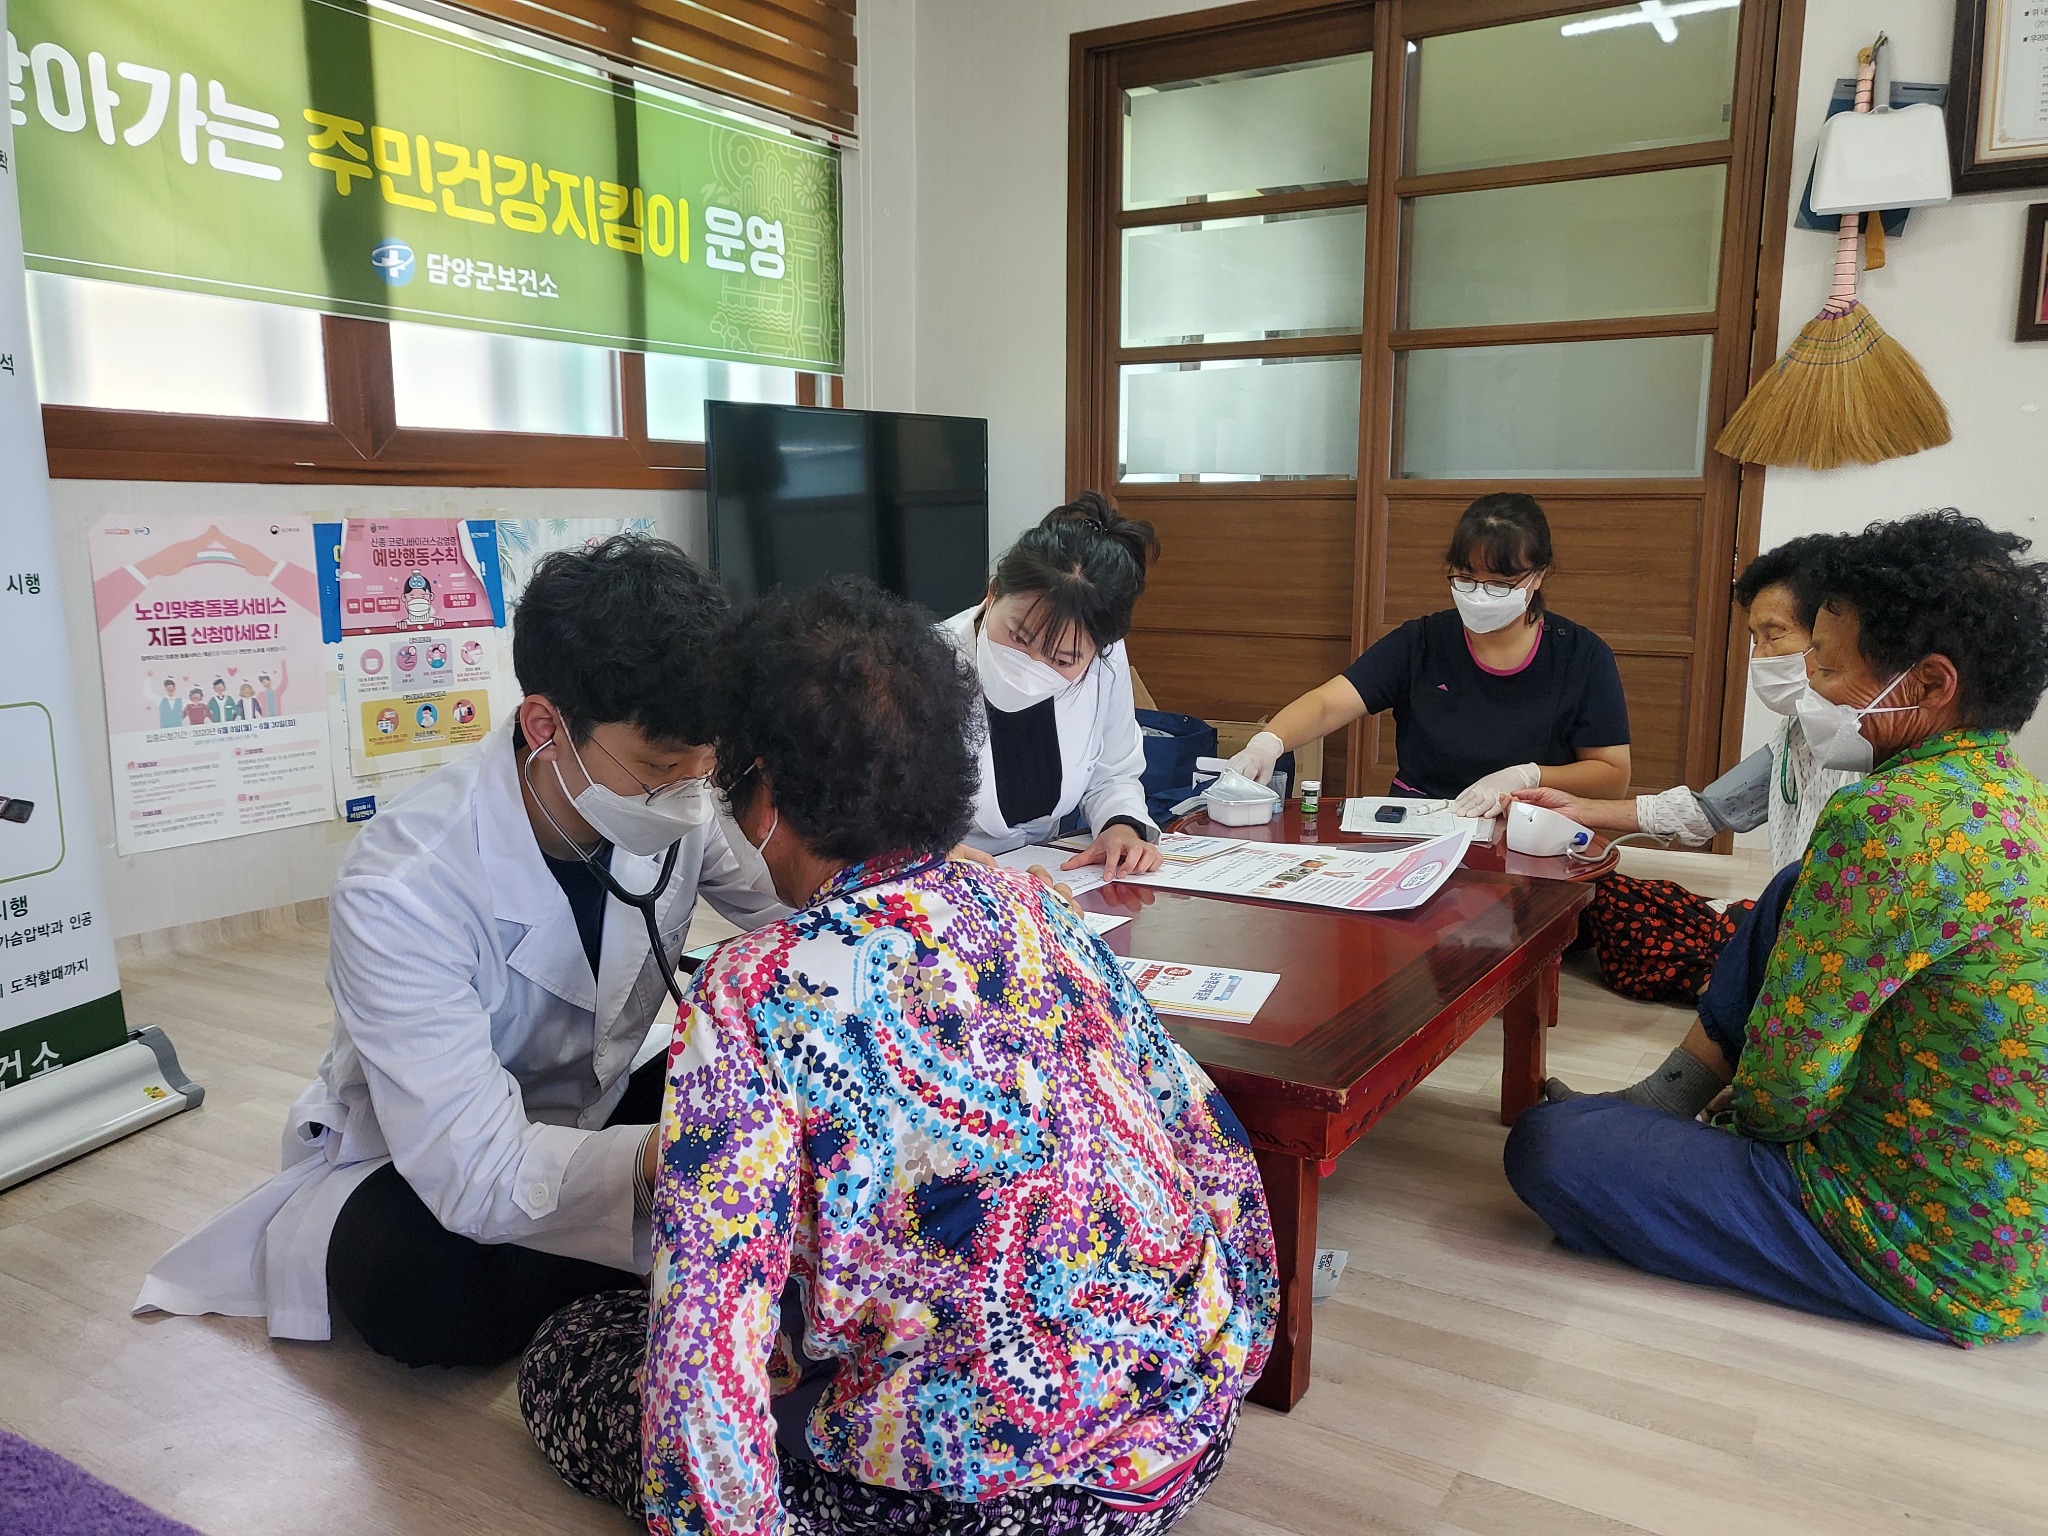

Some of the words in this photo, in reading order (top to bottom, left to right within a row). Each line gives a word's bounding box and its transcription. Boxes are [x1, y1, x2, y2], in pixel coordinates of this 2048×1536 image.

[303, 107, 691, 264] 주민건강지킴이
[704, 205, 787, 281] 운영
[427, 252, 560, 300] 담양군보건소
[370, 537, 386, 548] 신종
[388, 536, 457, 547] 코로나바이러스감염증
[372, 547, 458, 567] 예방행동수칙
[6, 573, 41, 596] 시행
[135, 597, 287, 621] 노인맞춤돌봄서비스
[147, 625, 187, 647] 지금
[191, 623, 279, 645] 신청하세요!
[0, 919, 64, 949] 가슴압박과
[69, 911, 93, 930] 인공
[10, 957, 89, 994] 도착할때까지
